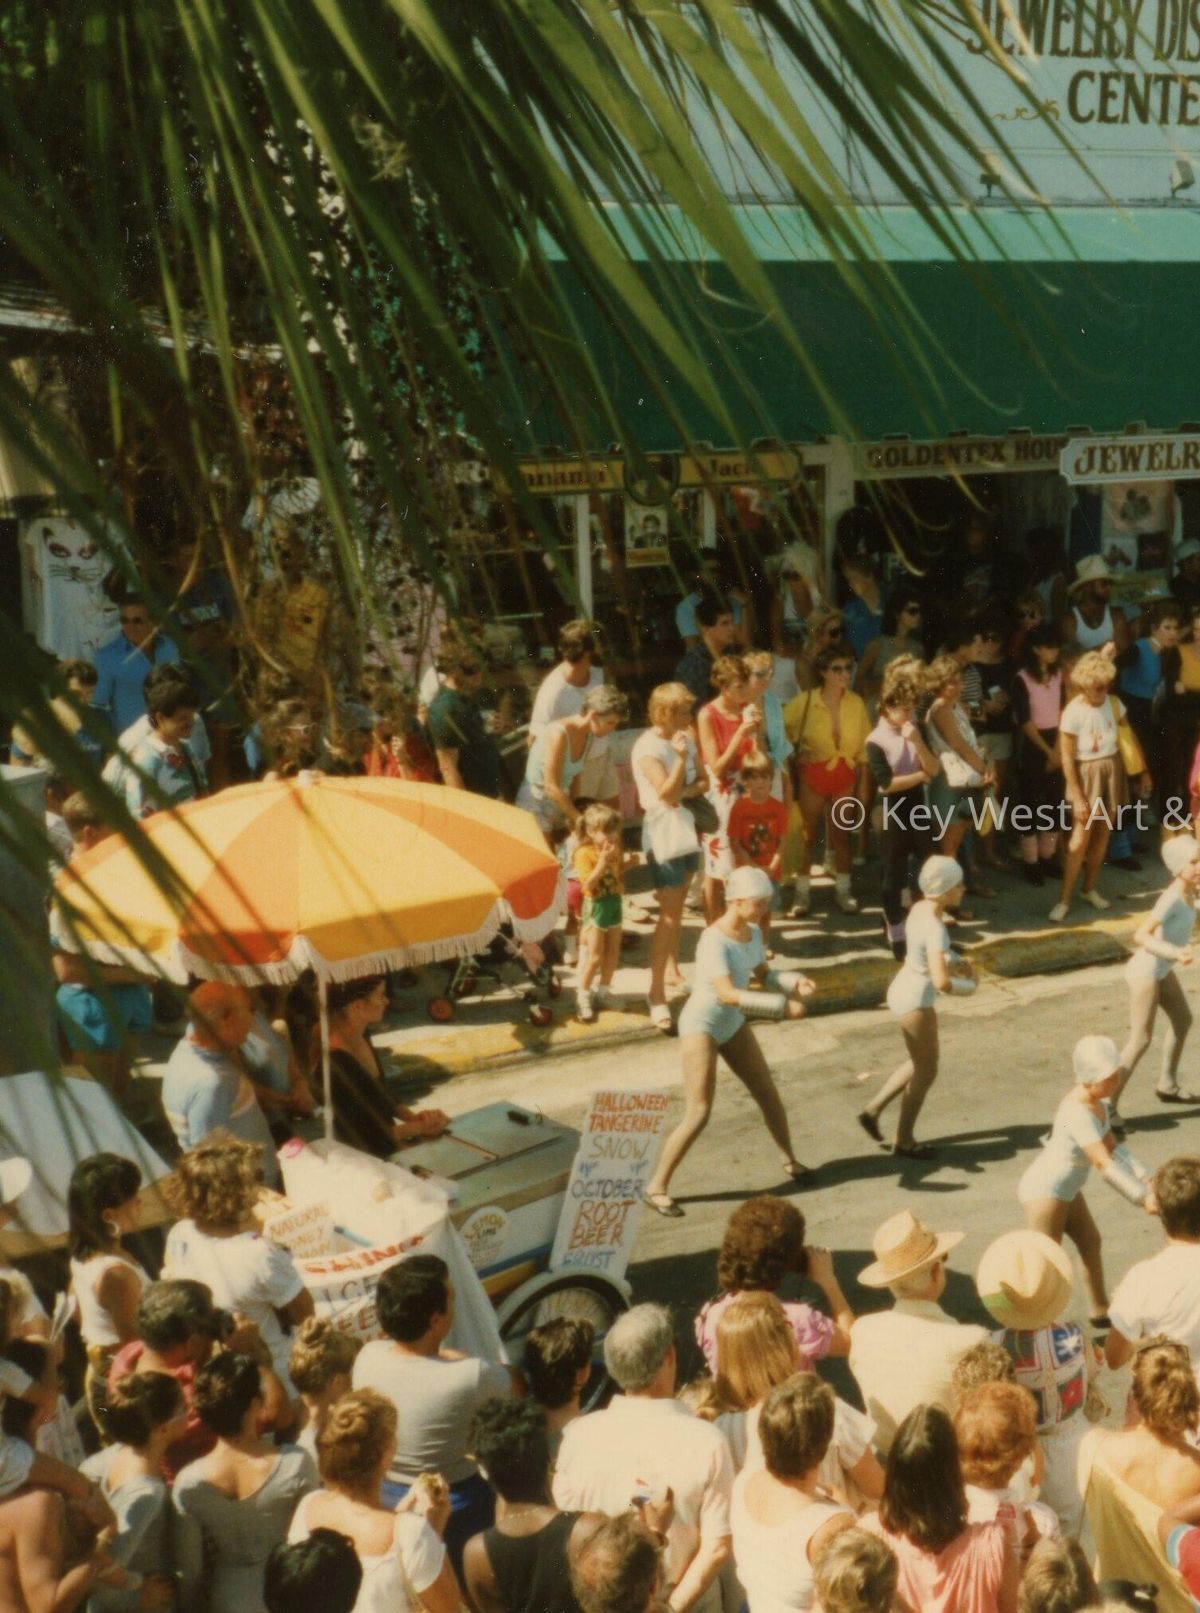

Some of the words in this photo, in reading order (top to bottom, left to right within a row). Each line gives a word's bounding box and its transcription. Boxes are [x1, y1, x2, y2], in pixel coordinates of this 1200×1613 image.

[966, 0, 1146, 60] JEWELRY
[589, 1113, 664, 1134] TANGERINE
[588, 1134, 651, 1159] SNOW
[571, 1179, 644, 1199] OCTOBER
[574, 1199, 636, 1226] ROOT
[568, 1222, 624, 1250] BEER
